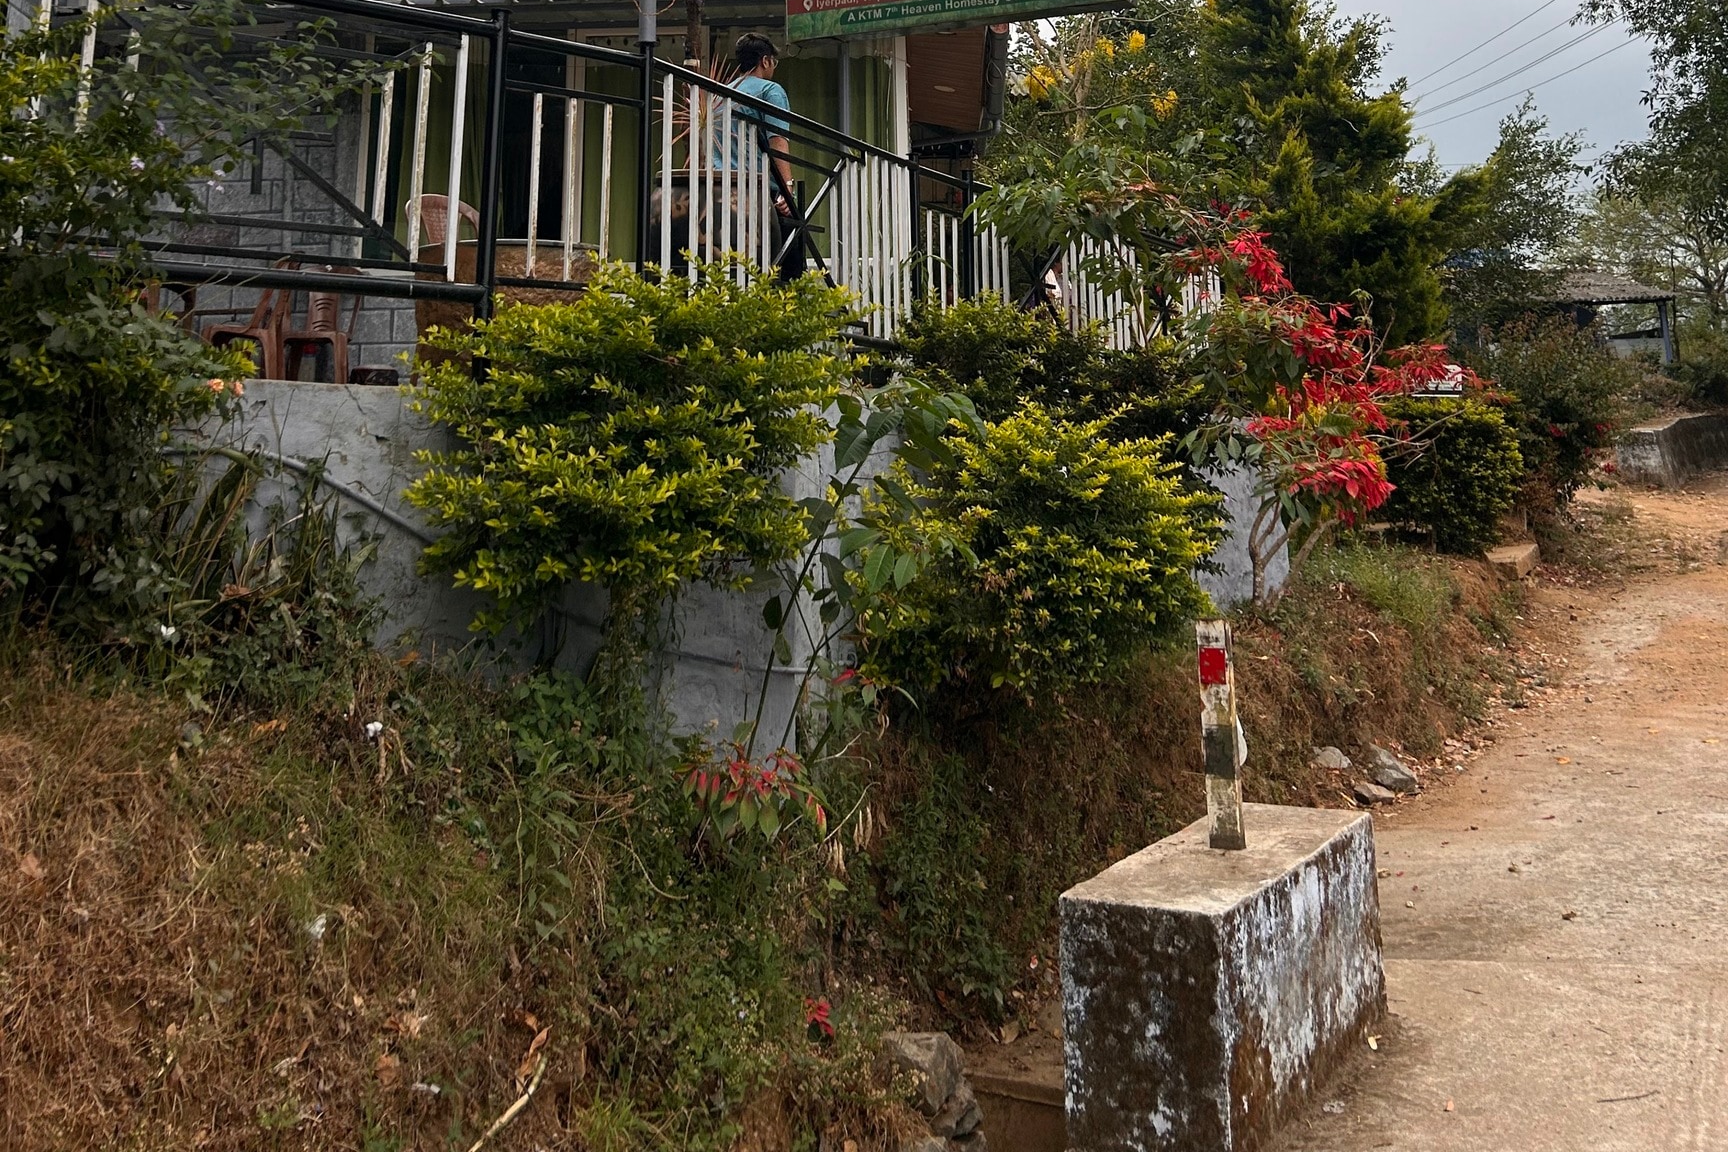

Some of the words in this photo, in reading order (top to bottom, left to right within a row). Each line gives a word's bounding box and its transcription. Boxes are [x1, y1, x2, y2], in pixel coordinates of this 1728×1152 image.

[847, 13, 856, 22] A
[858, 8, 882, 21] KTM
[901, 1, 942, 15] Heaven
